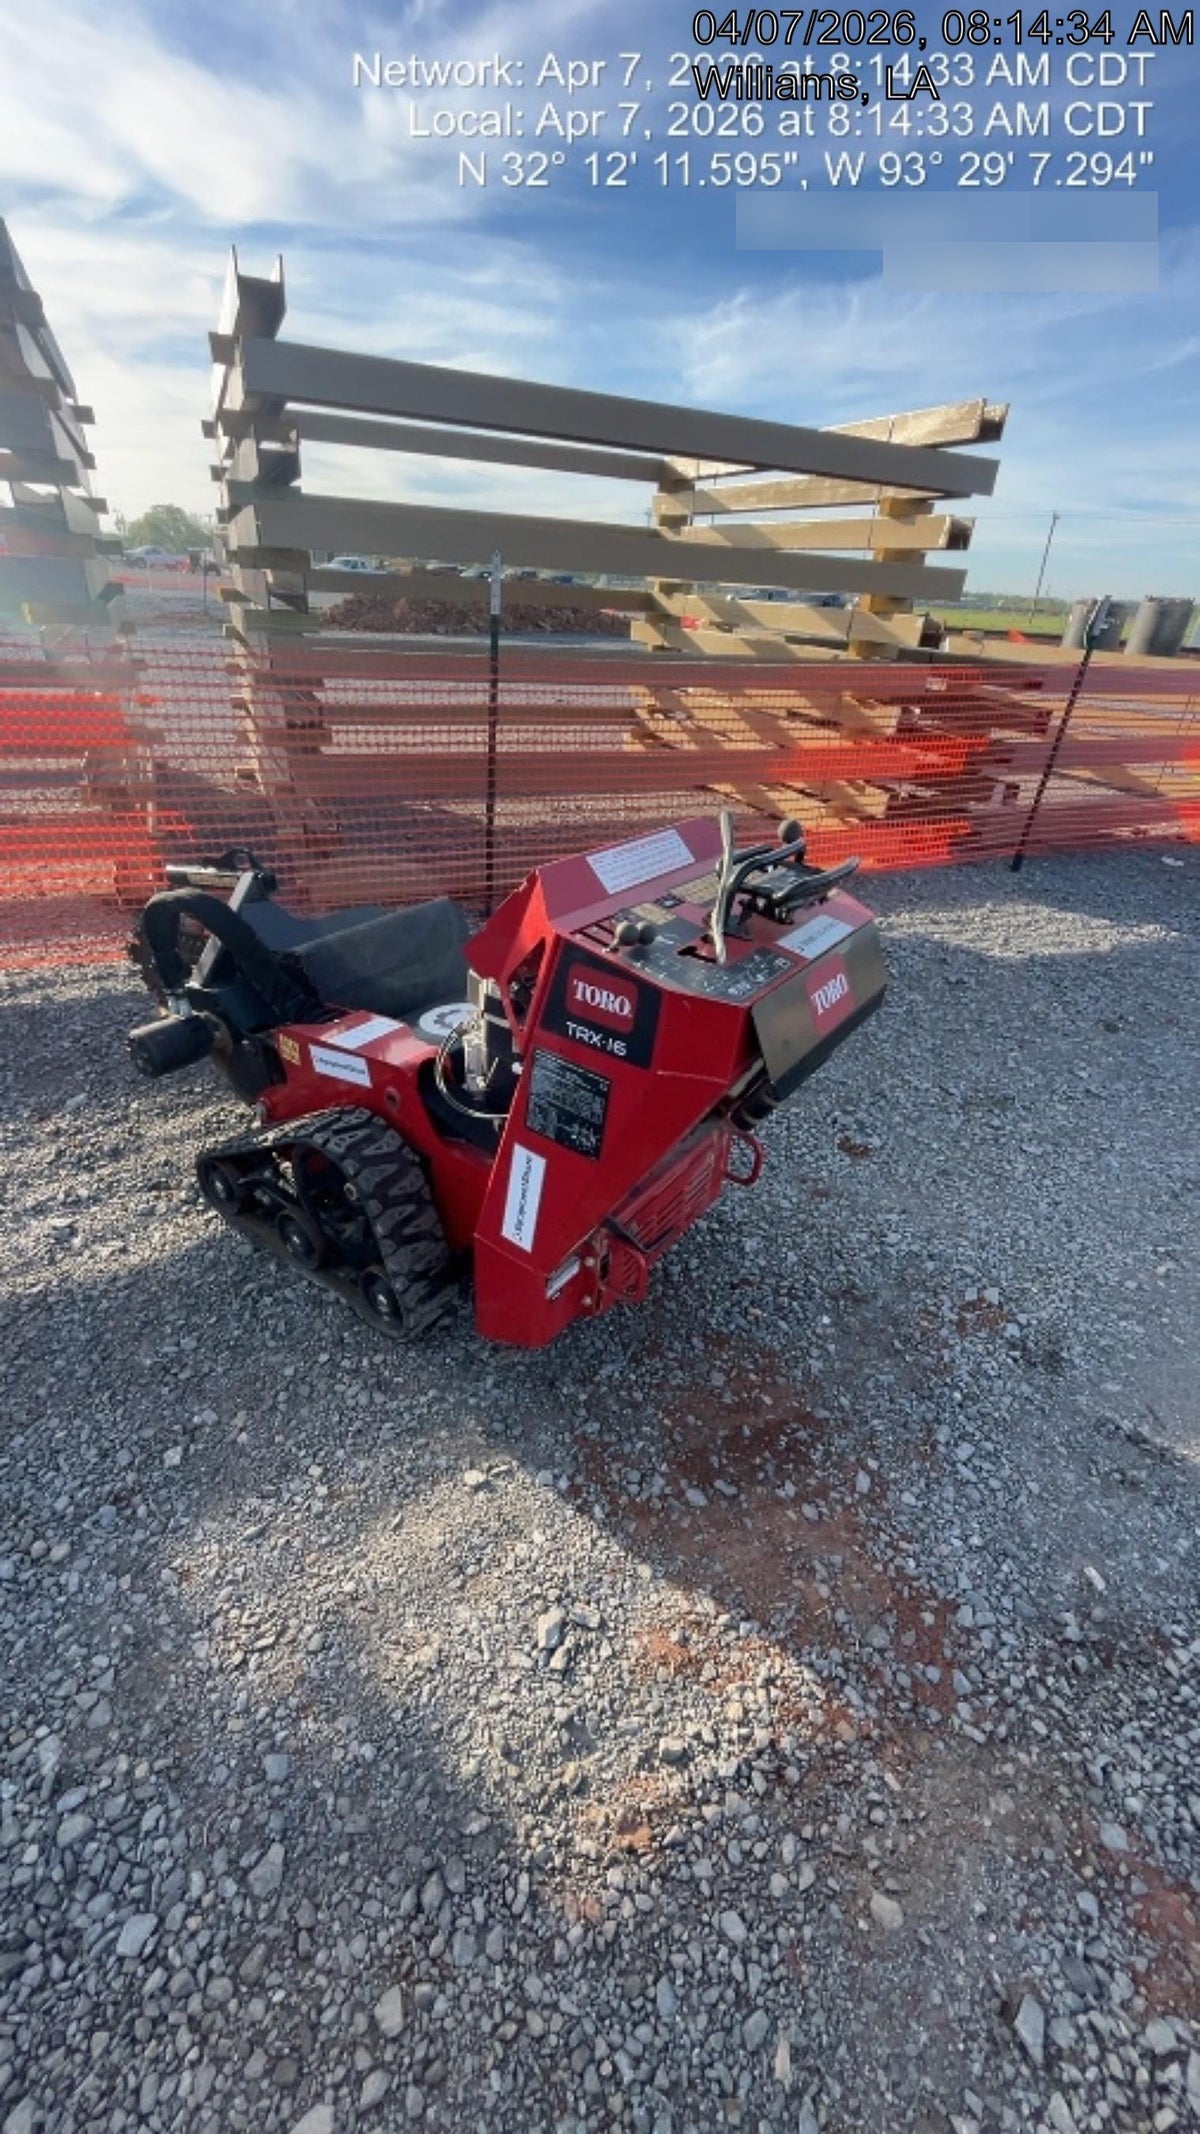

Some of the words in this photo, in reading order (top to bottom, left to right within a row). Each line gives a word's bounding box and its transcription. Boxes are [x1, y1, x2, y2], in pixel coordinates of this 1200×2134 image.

[573, 979, 633, 1018] TORO
[810, 972, 849, 1015] TORO
[566, 1021, 627, 1056] TRX-16
